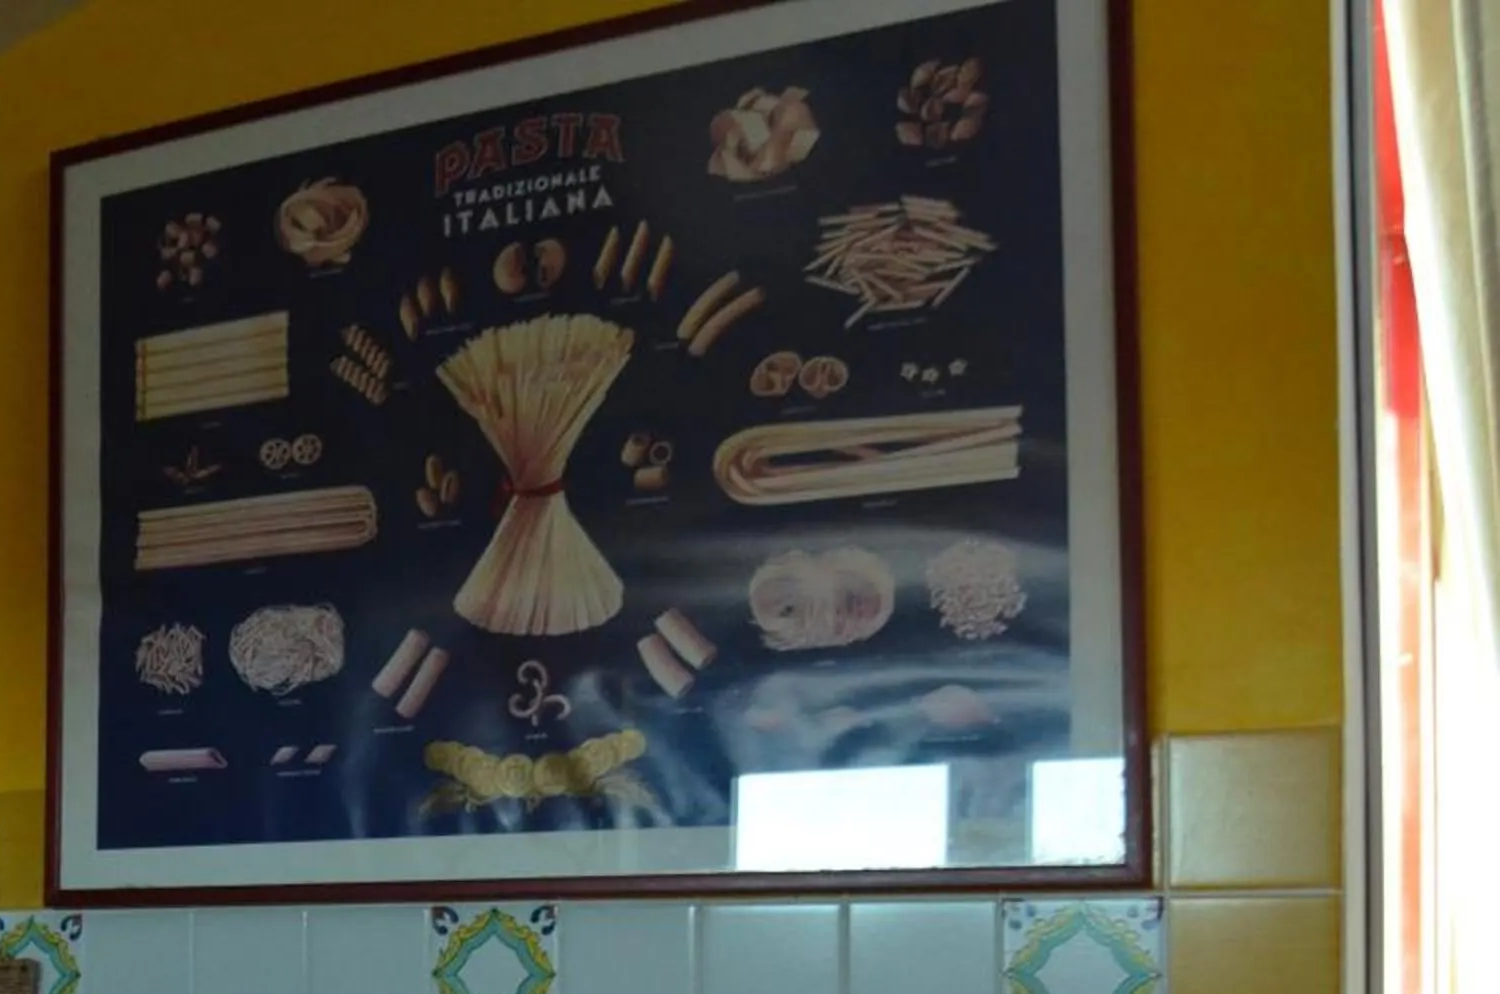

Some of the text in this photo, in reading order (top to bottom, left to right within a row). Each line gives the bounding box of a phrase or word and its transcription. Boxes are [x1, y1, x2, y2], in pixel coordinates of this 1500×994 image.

[433, 112, 627, 199] PASTA
[443, 185, 614, 239] ITALIANA
[453, 164, 602, 208] TRADIZIONALE
